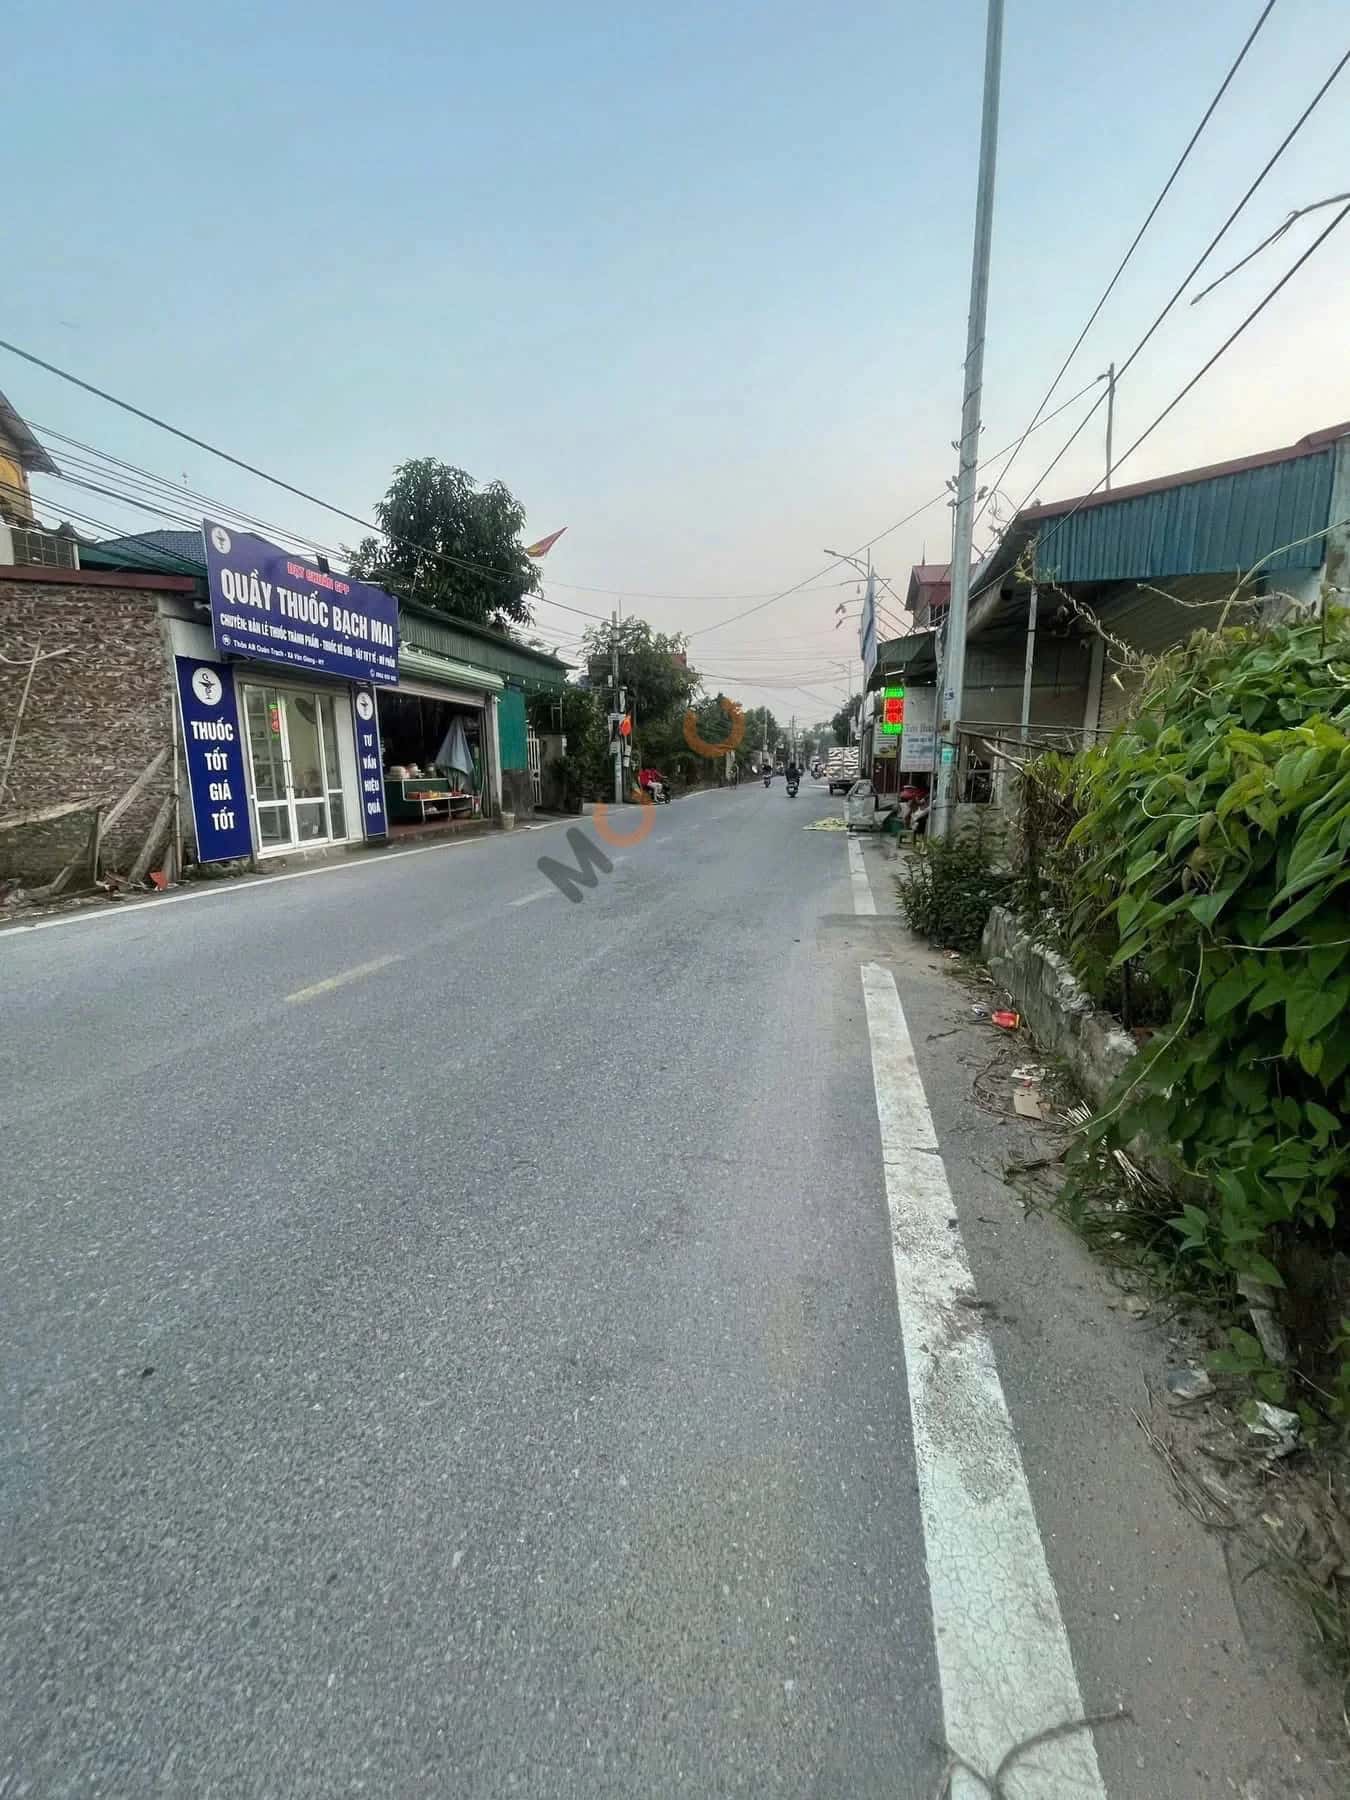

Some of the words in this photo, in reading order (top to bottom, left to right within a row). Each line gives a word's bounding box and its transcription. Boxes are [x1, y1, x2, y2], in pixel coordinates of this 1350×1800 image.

[220, 567, 272, 611] QUẦY
[276, 586, 329, 628] THUỐC
[332, 605, 368, 640] BẠCH
[370, 618, 393, 648] MAI
[190, 716, 235, 742] THUỐC
[204, 747, 229, 771] TỐT
[208, 779, 233, 801] GIÁ
[211, 806, 236, 831] TỐT
